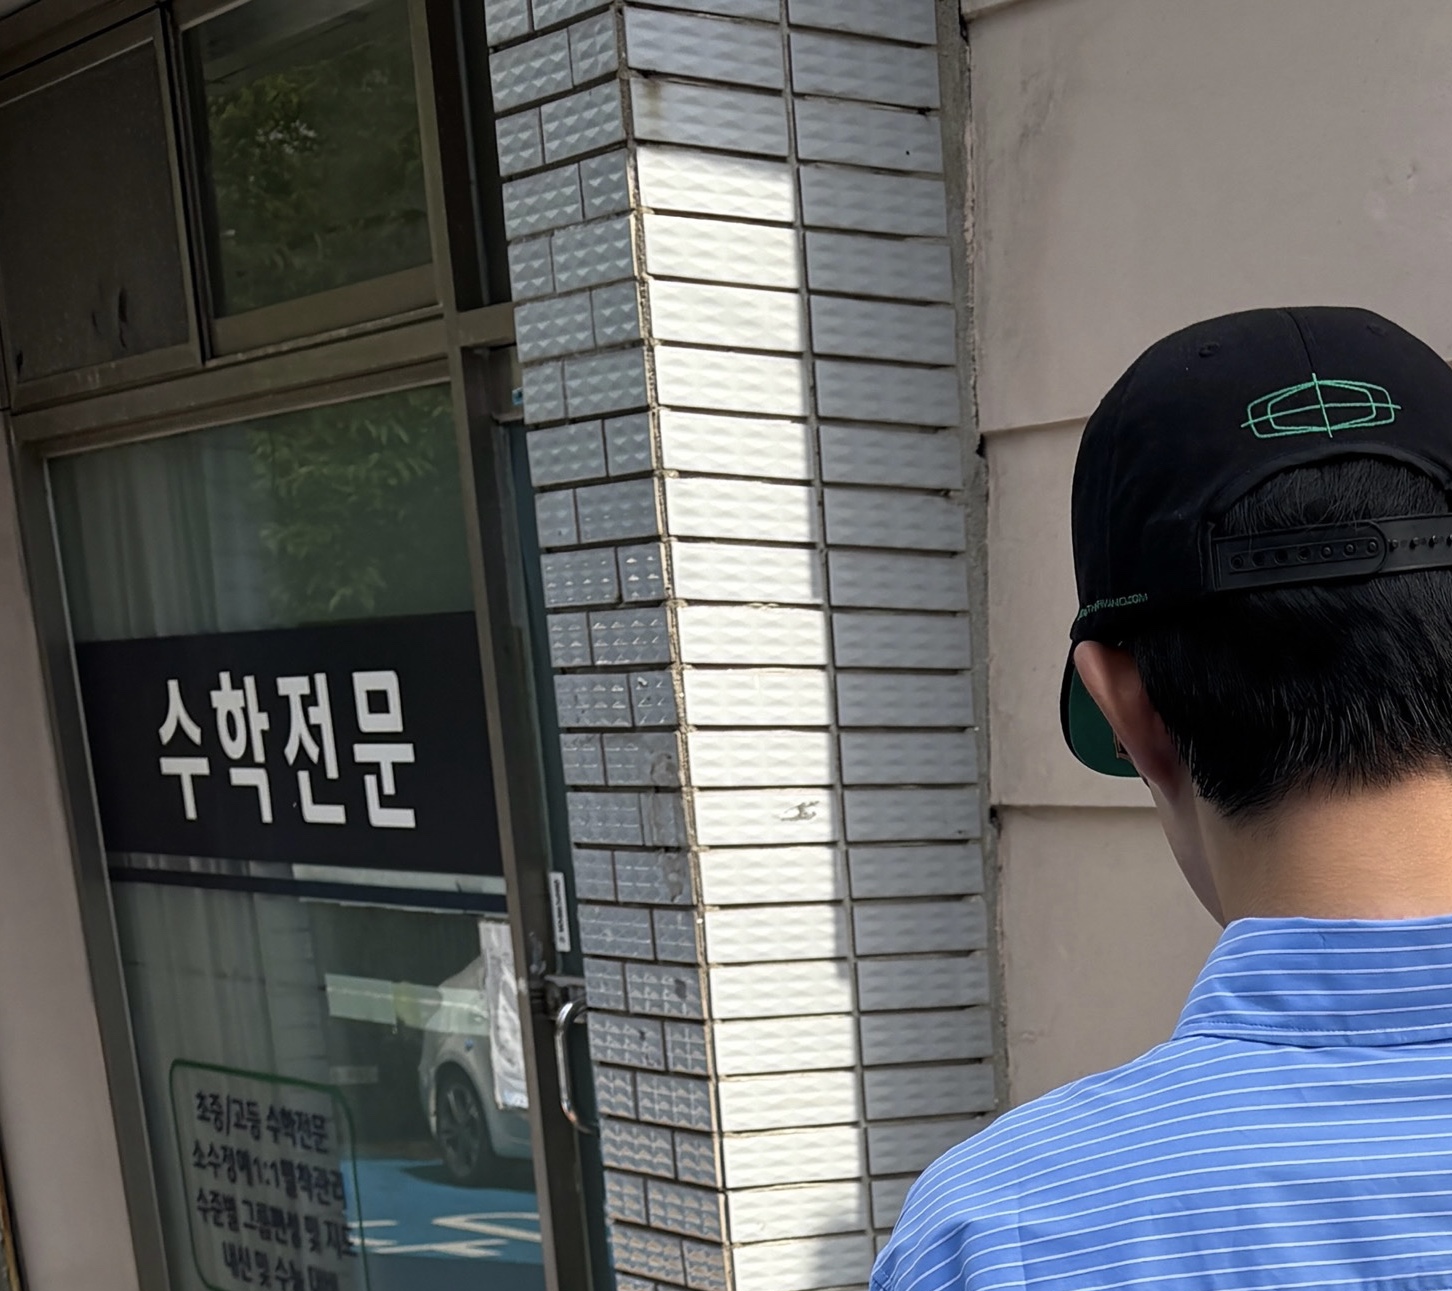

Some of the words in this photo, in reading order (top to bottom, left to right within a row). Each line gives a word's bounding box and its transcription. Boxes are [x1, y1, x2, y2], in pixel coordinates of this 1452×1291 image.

[157, 669, 417, 829] 수학전문
[267, 1104, 329, 1154] 수학전문
[197, 1187, 240, 1233] 수준별
[304, 1216, 322, 1254] 및
[222, 1240, 253, 1283] 내신
[255, 1250, 272, 1288] 및
